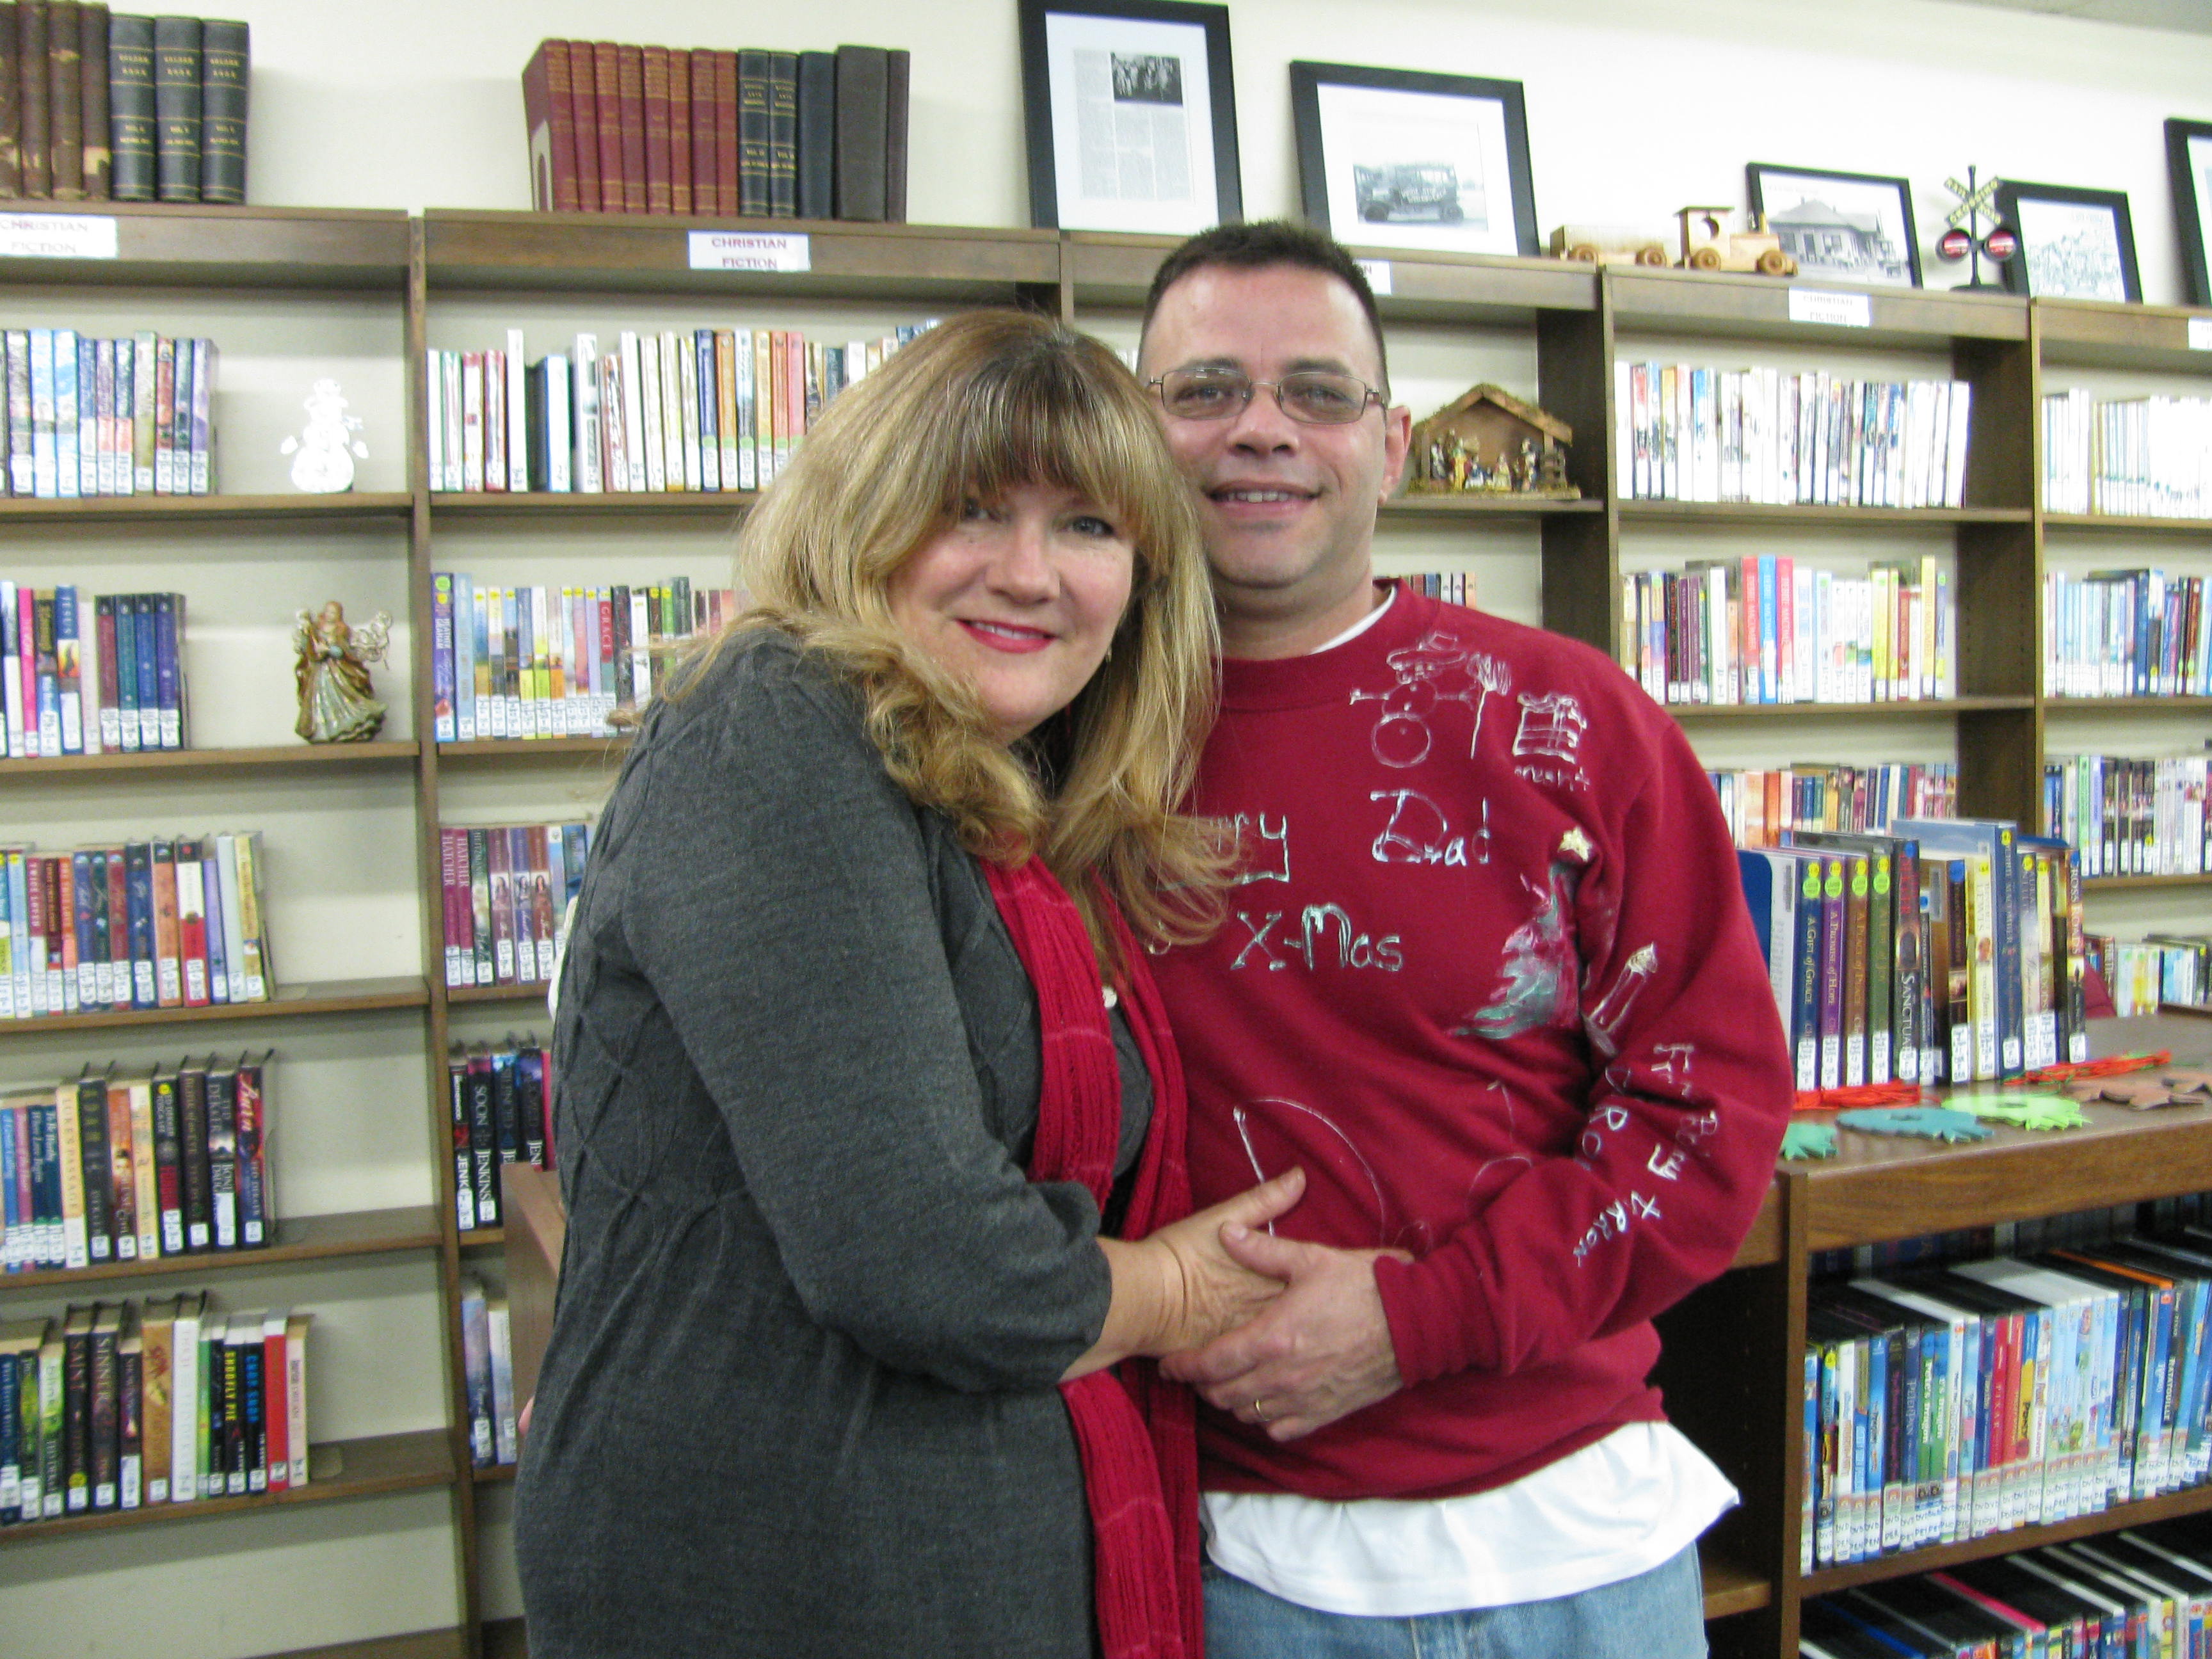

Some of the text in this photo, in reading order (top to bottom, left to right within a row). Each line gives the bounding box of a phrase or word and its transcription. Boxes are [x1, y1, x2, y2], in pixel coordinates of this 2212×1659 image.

[1, 219, 88, 231] CHRISTIAN
[712, 237, 788, 250] CHRISTIAN
[11, 241, 77, 253] FICTION
[721, 257, 778, 269] FICTION
[601, 605, 611, 652] GRACE
[442, 836, 454, 886] HATCHER
[456, 837, 469, 887] HATCHER
[1807, 917, 1816, 926] A
[1829, 911, 1838, 920] A
[1805, 956, 1814, 966] of
[1827, 967, 1836, 976] of
[1902, 972, 1914, 1052] SANCTUA
[209, 1084, 221, 1132] DEKKER
[222, 1100, 231, 1121] TED
[474, 1086, 488, 1126] SOON
[457, 1155, 469, 1190] JENK
[474, 1149, 492, 1201] JENKINS
[94, 1337, 111, 1401] SINNER
[225, 1350, 237, 1422] SHOOFLY PIE
[2163, 1357, 2176, 1421] RATATOUILLE
